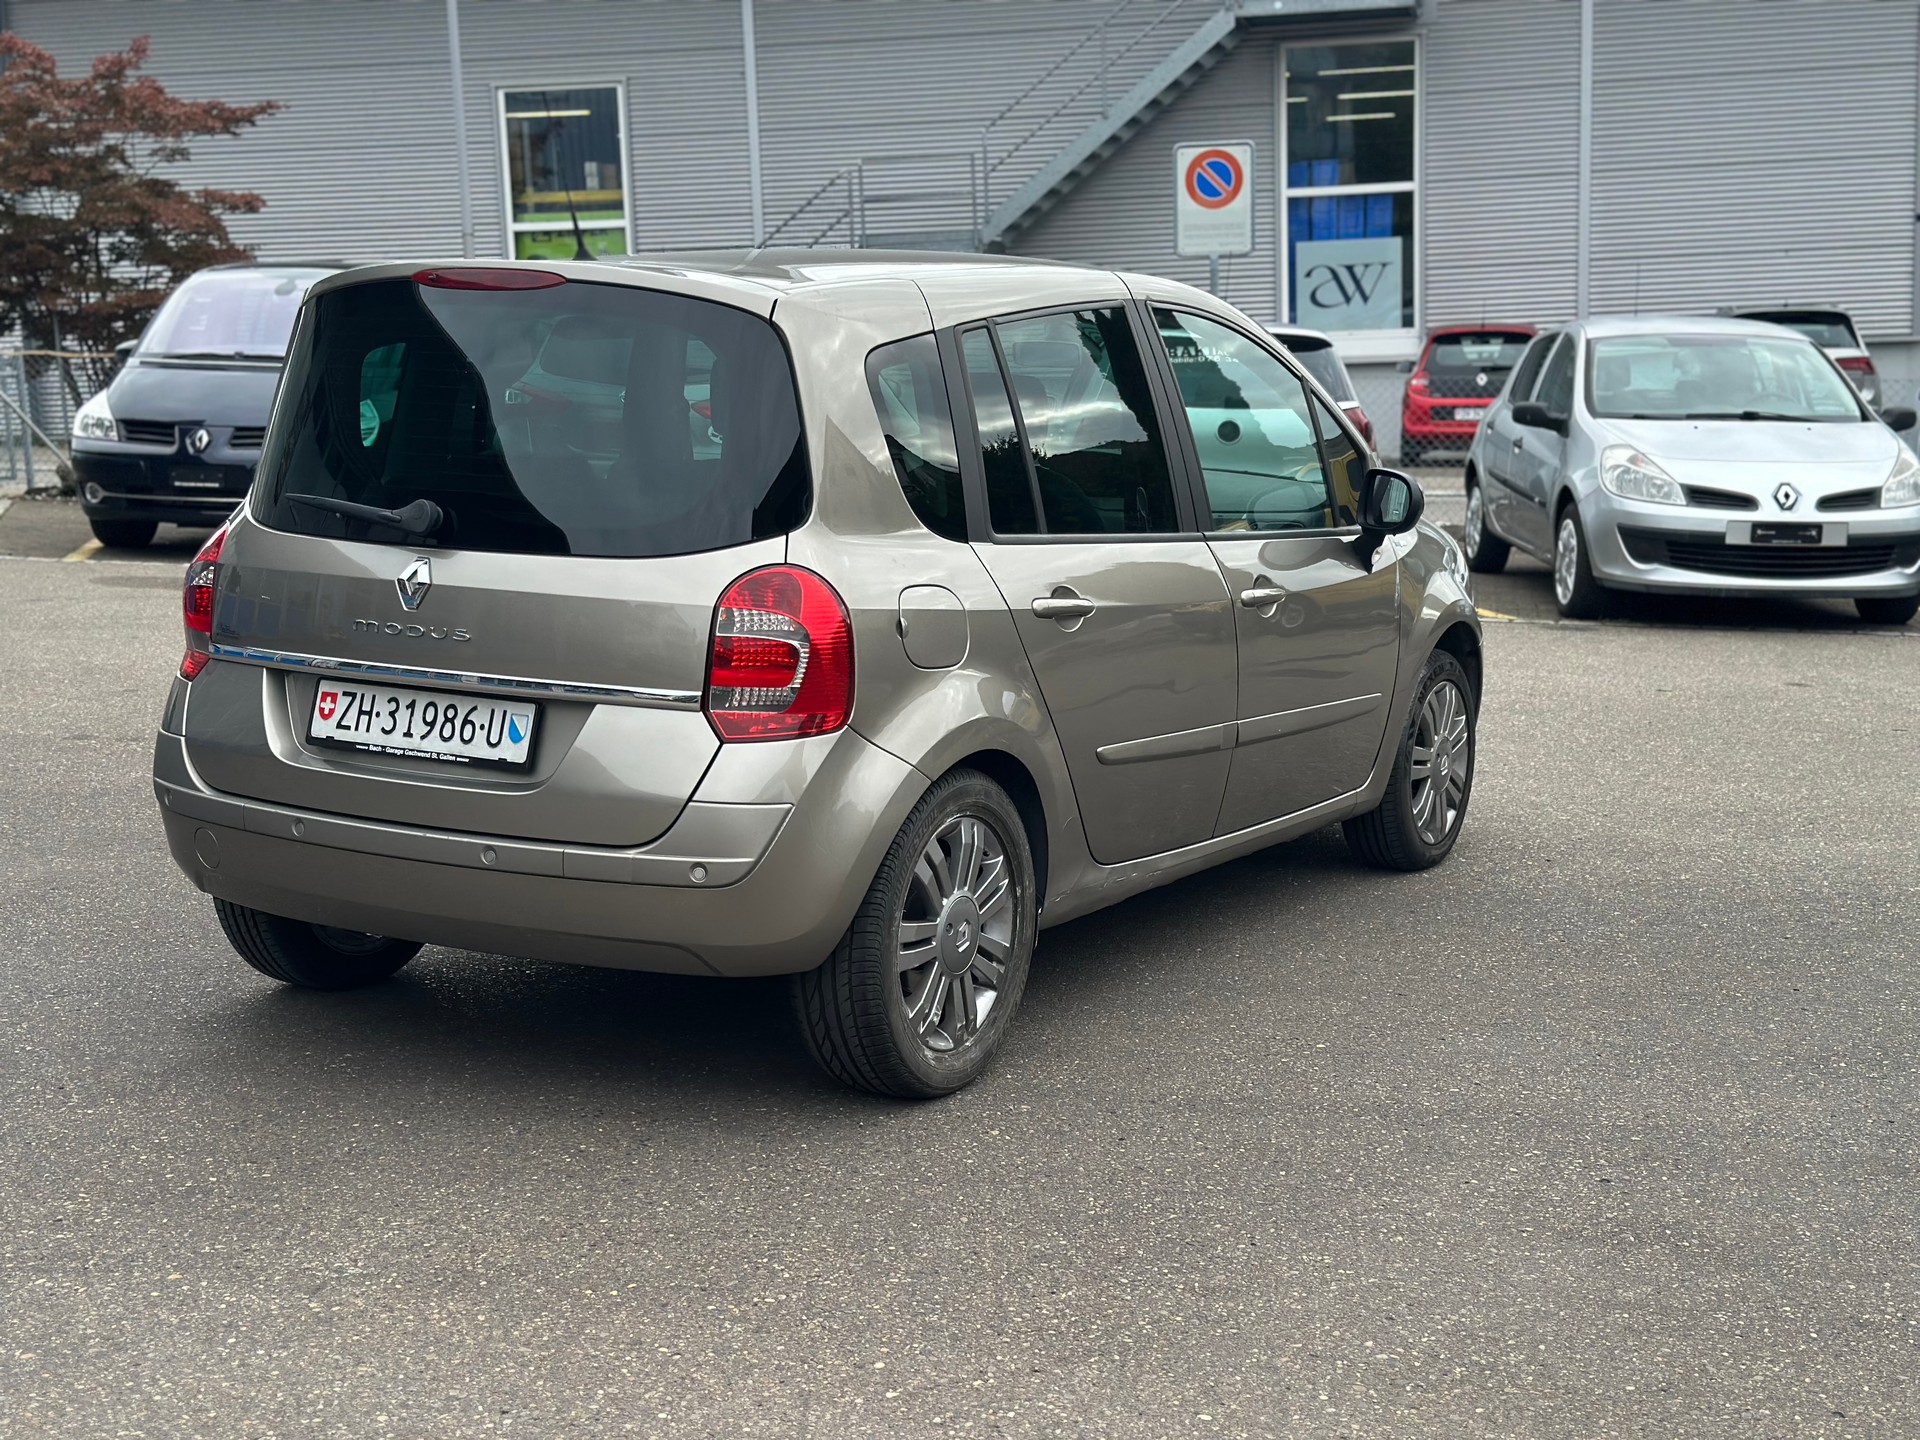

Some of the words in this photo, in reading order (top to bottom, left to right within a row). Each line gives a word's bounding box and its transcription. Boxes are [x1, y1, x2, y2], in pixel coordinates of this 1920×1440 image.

[352, 618, 472, 641] MODUS
[386, 746, 404, 755] Garage
[439, 753, 456, 761] Gallen
